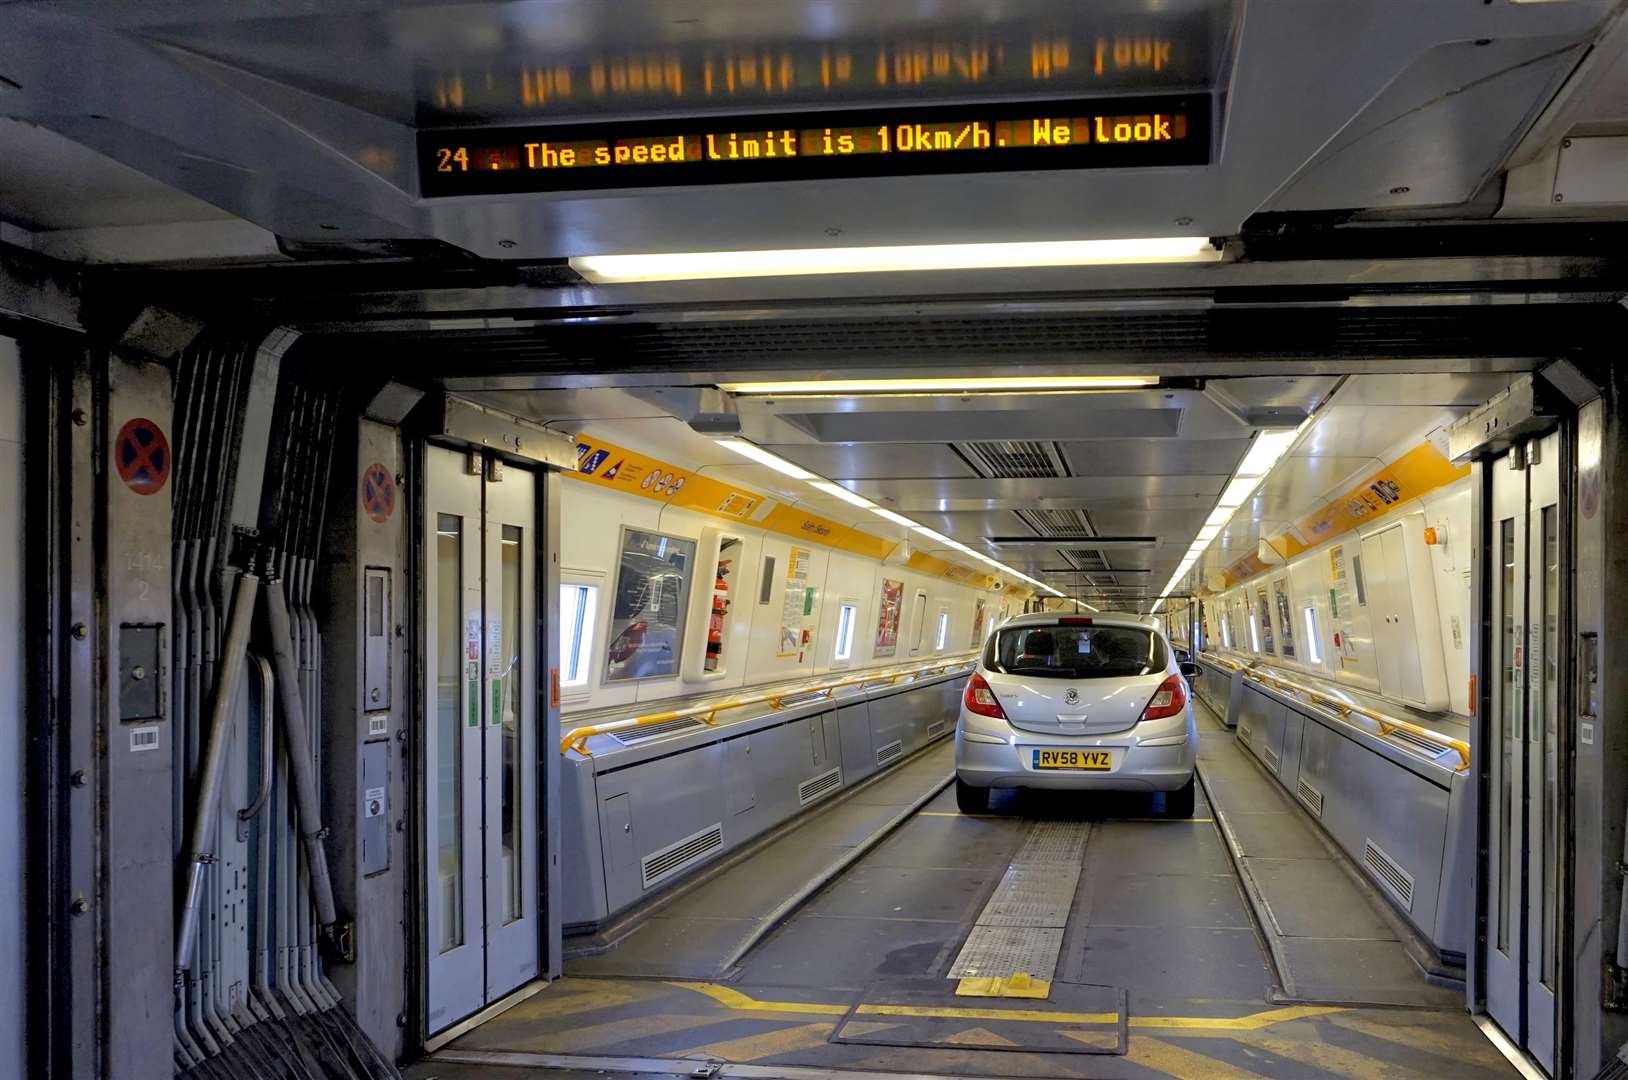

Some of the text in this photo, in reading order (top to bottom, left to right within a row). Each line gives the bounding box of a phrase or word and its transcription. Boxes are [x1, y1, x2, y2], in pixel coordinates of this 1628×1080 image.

[437, 148, 468, 172] 24
[524, 143, 576, 168] The
[594, 136, 685, 165] speed
[706, 130, 797, 160] limit
[823, 128, 855, 155] is
[877, 121, 1006, 152] 10km/h.
[1033, 118, 1071, 145] We
[1094, 114, 1171, 143] look
[1042, 751, 1078, 765] RV58
[1083, 752, 1109, 766] YVZ
